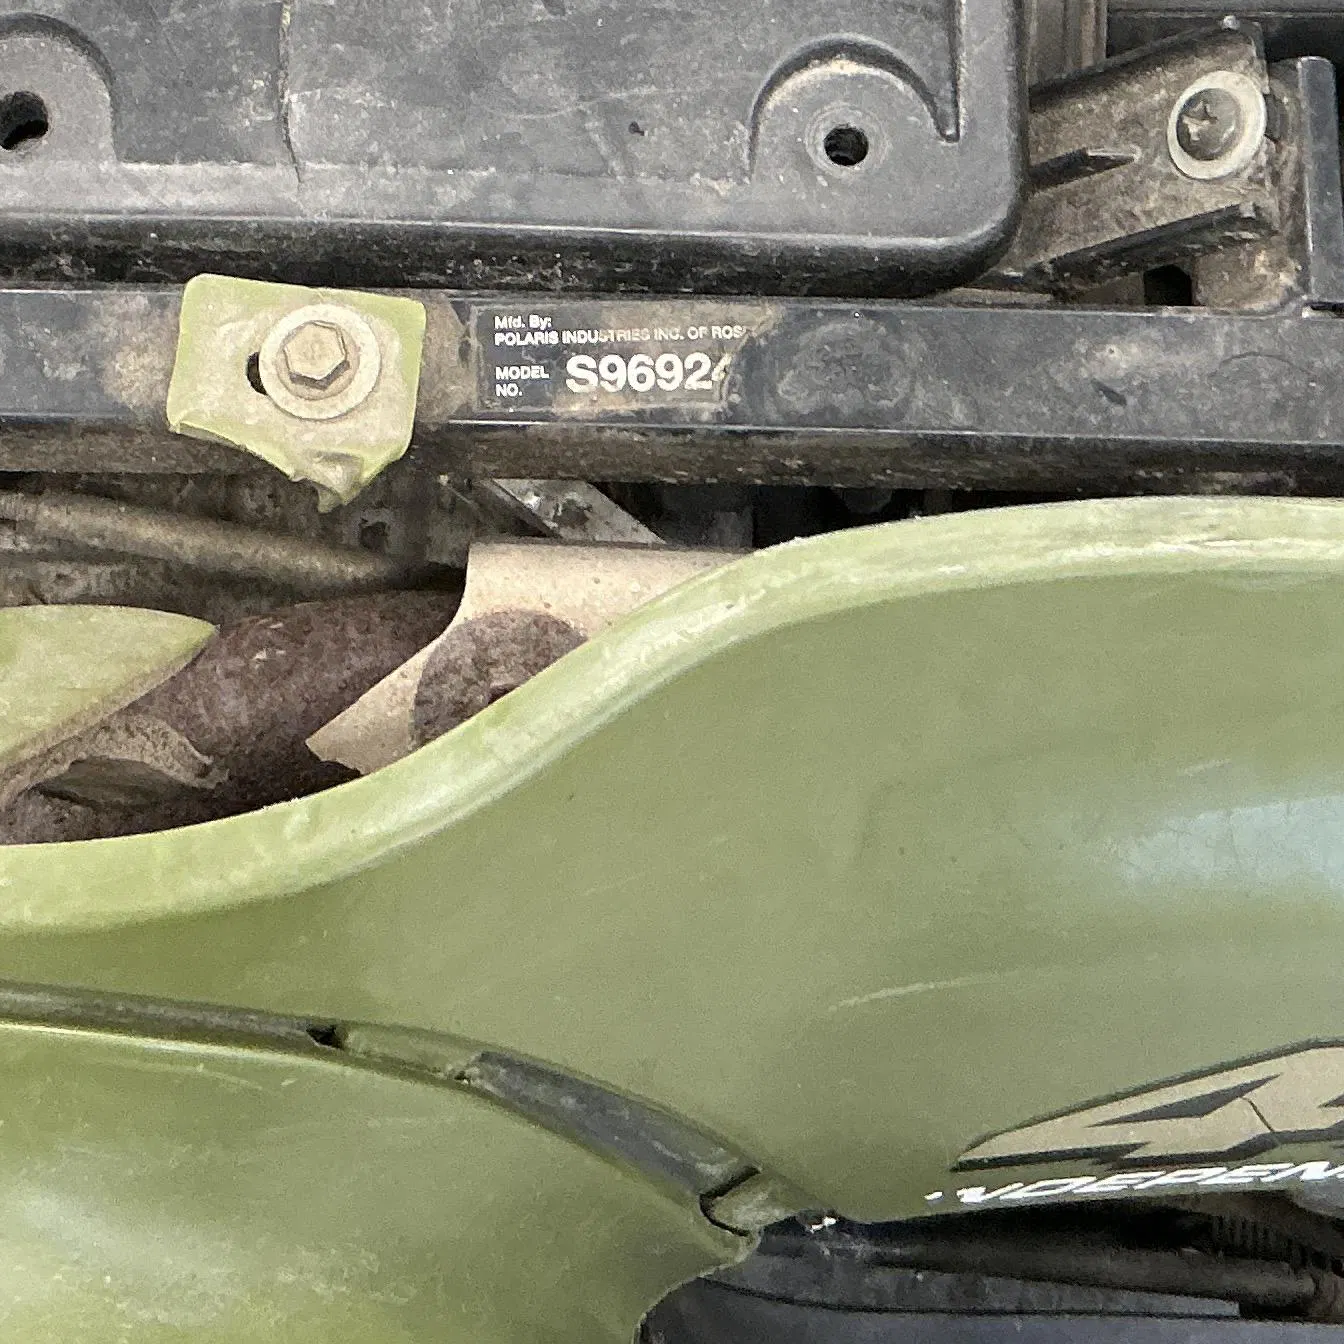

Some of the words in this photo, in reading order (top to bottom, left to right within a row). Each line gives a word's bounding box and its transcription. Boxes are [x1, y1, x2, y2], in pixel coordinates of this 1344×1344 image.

[494, 314, 526, 330] Mfd.
[528, 314, 553, 331] By:
[494, 330, 559, 347] POLARIS
[561, 327, 651, 344] INDUSTRIES
[653, 326, 685, 342] INC.
[687, 325, 707, 341] OF
[710, 324, 748, 340] ROS
[494, 365, 551, 381] MODEL
[494, 382, 524, 398] NO.
